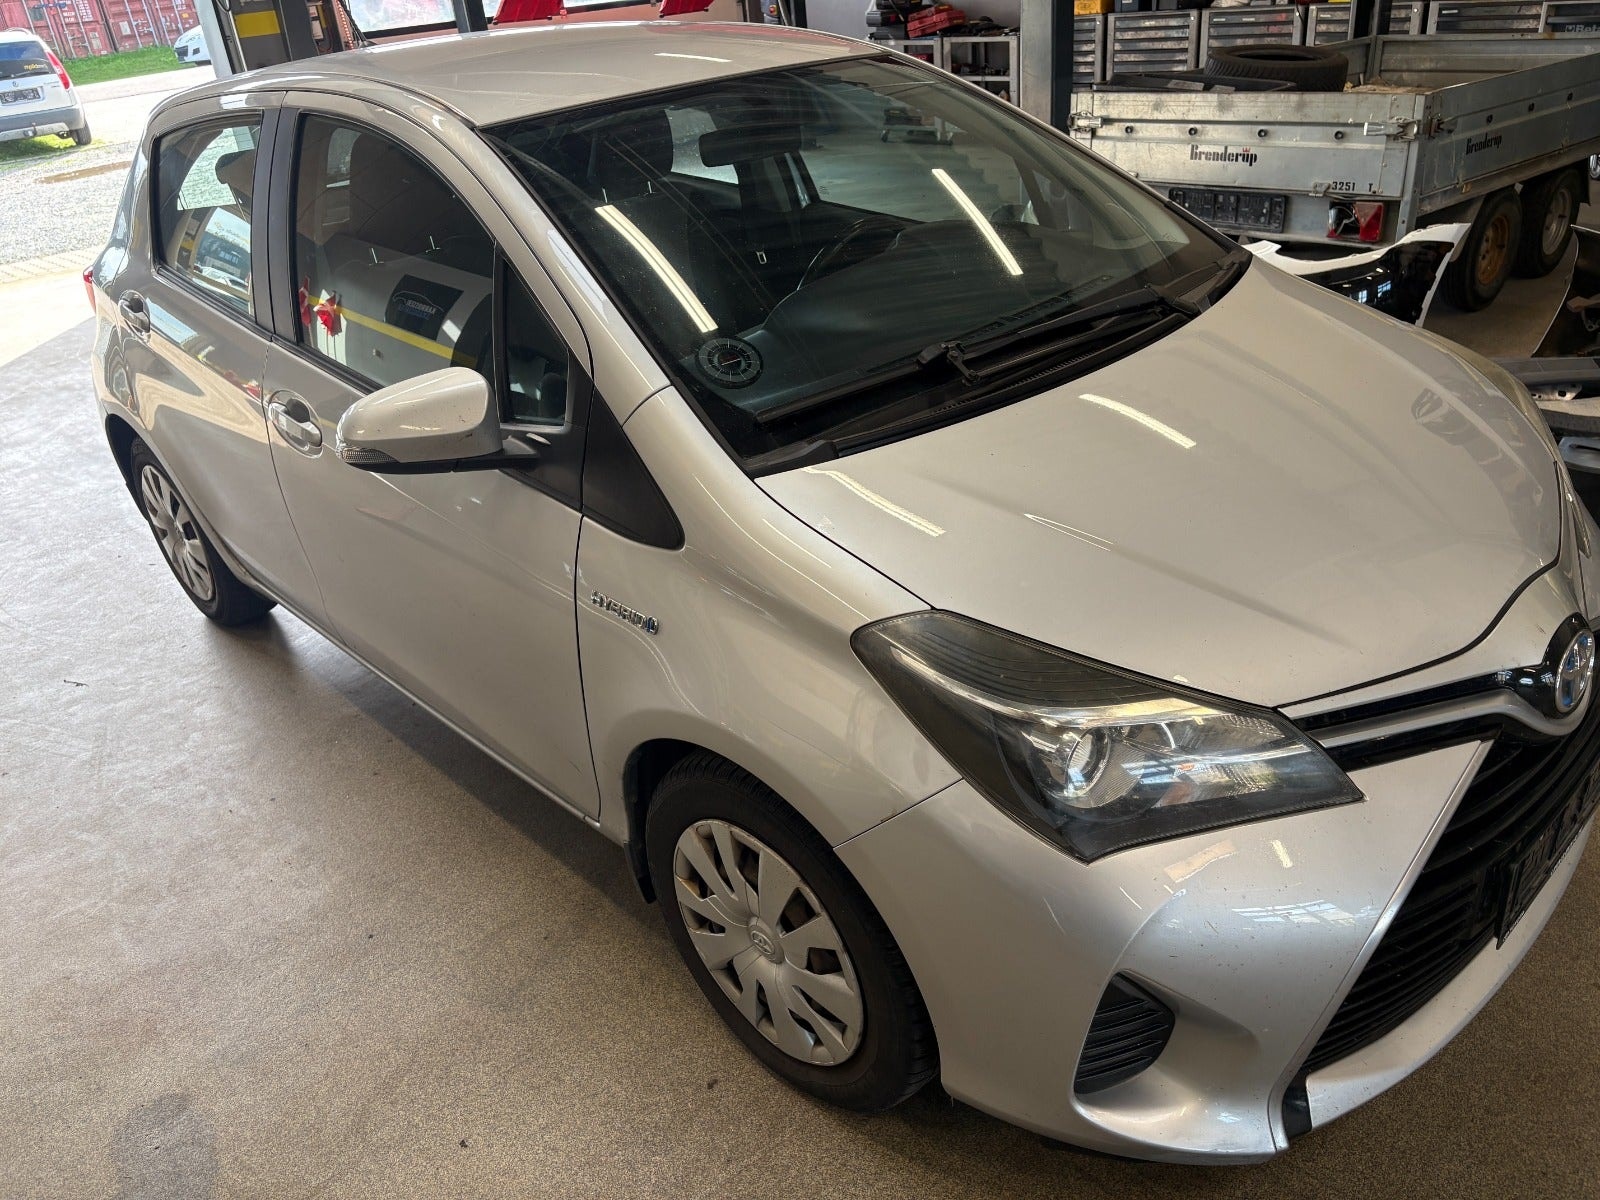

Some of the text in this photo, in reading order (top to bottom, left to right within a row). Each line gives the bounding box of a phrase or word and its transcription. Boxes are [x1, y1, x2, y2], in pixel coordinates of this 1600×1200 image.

[1576, 24, 1600, 33] Bet
[1190, 144, 1258, 167] Brenderup
[1331, 181, 1356, 191] 3251
[591, 589, 660, 635] HYBRID
